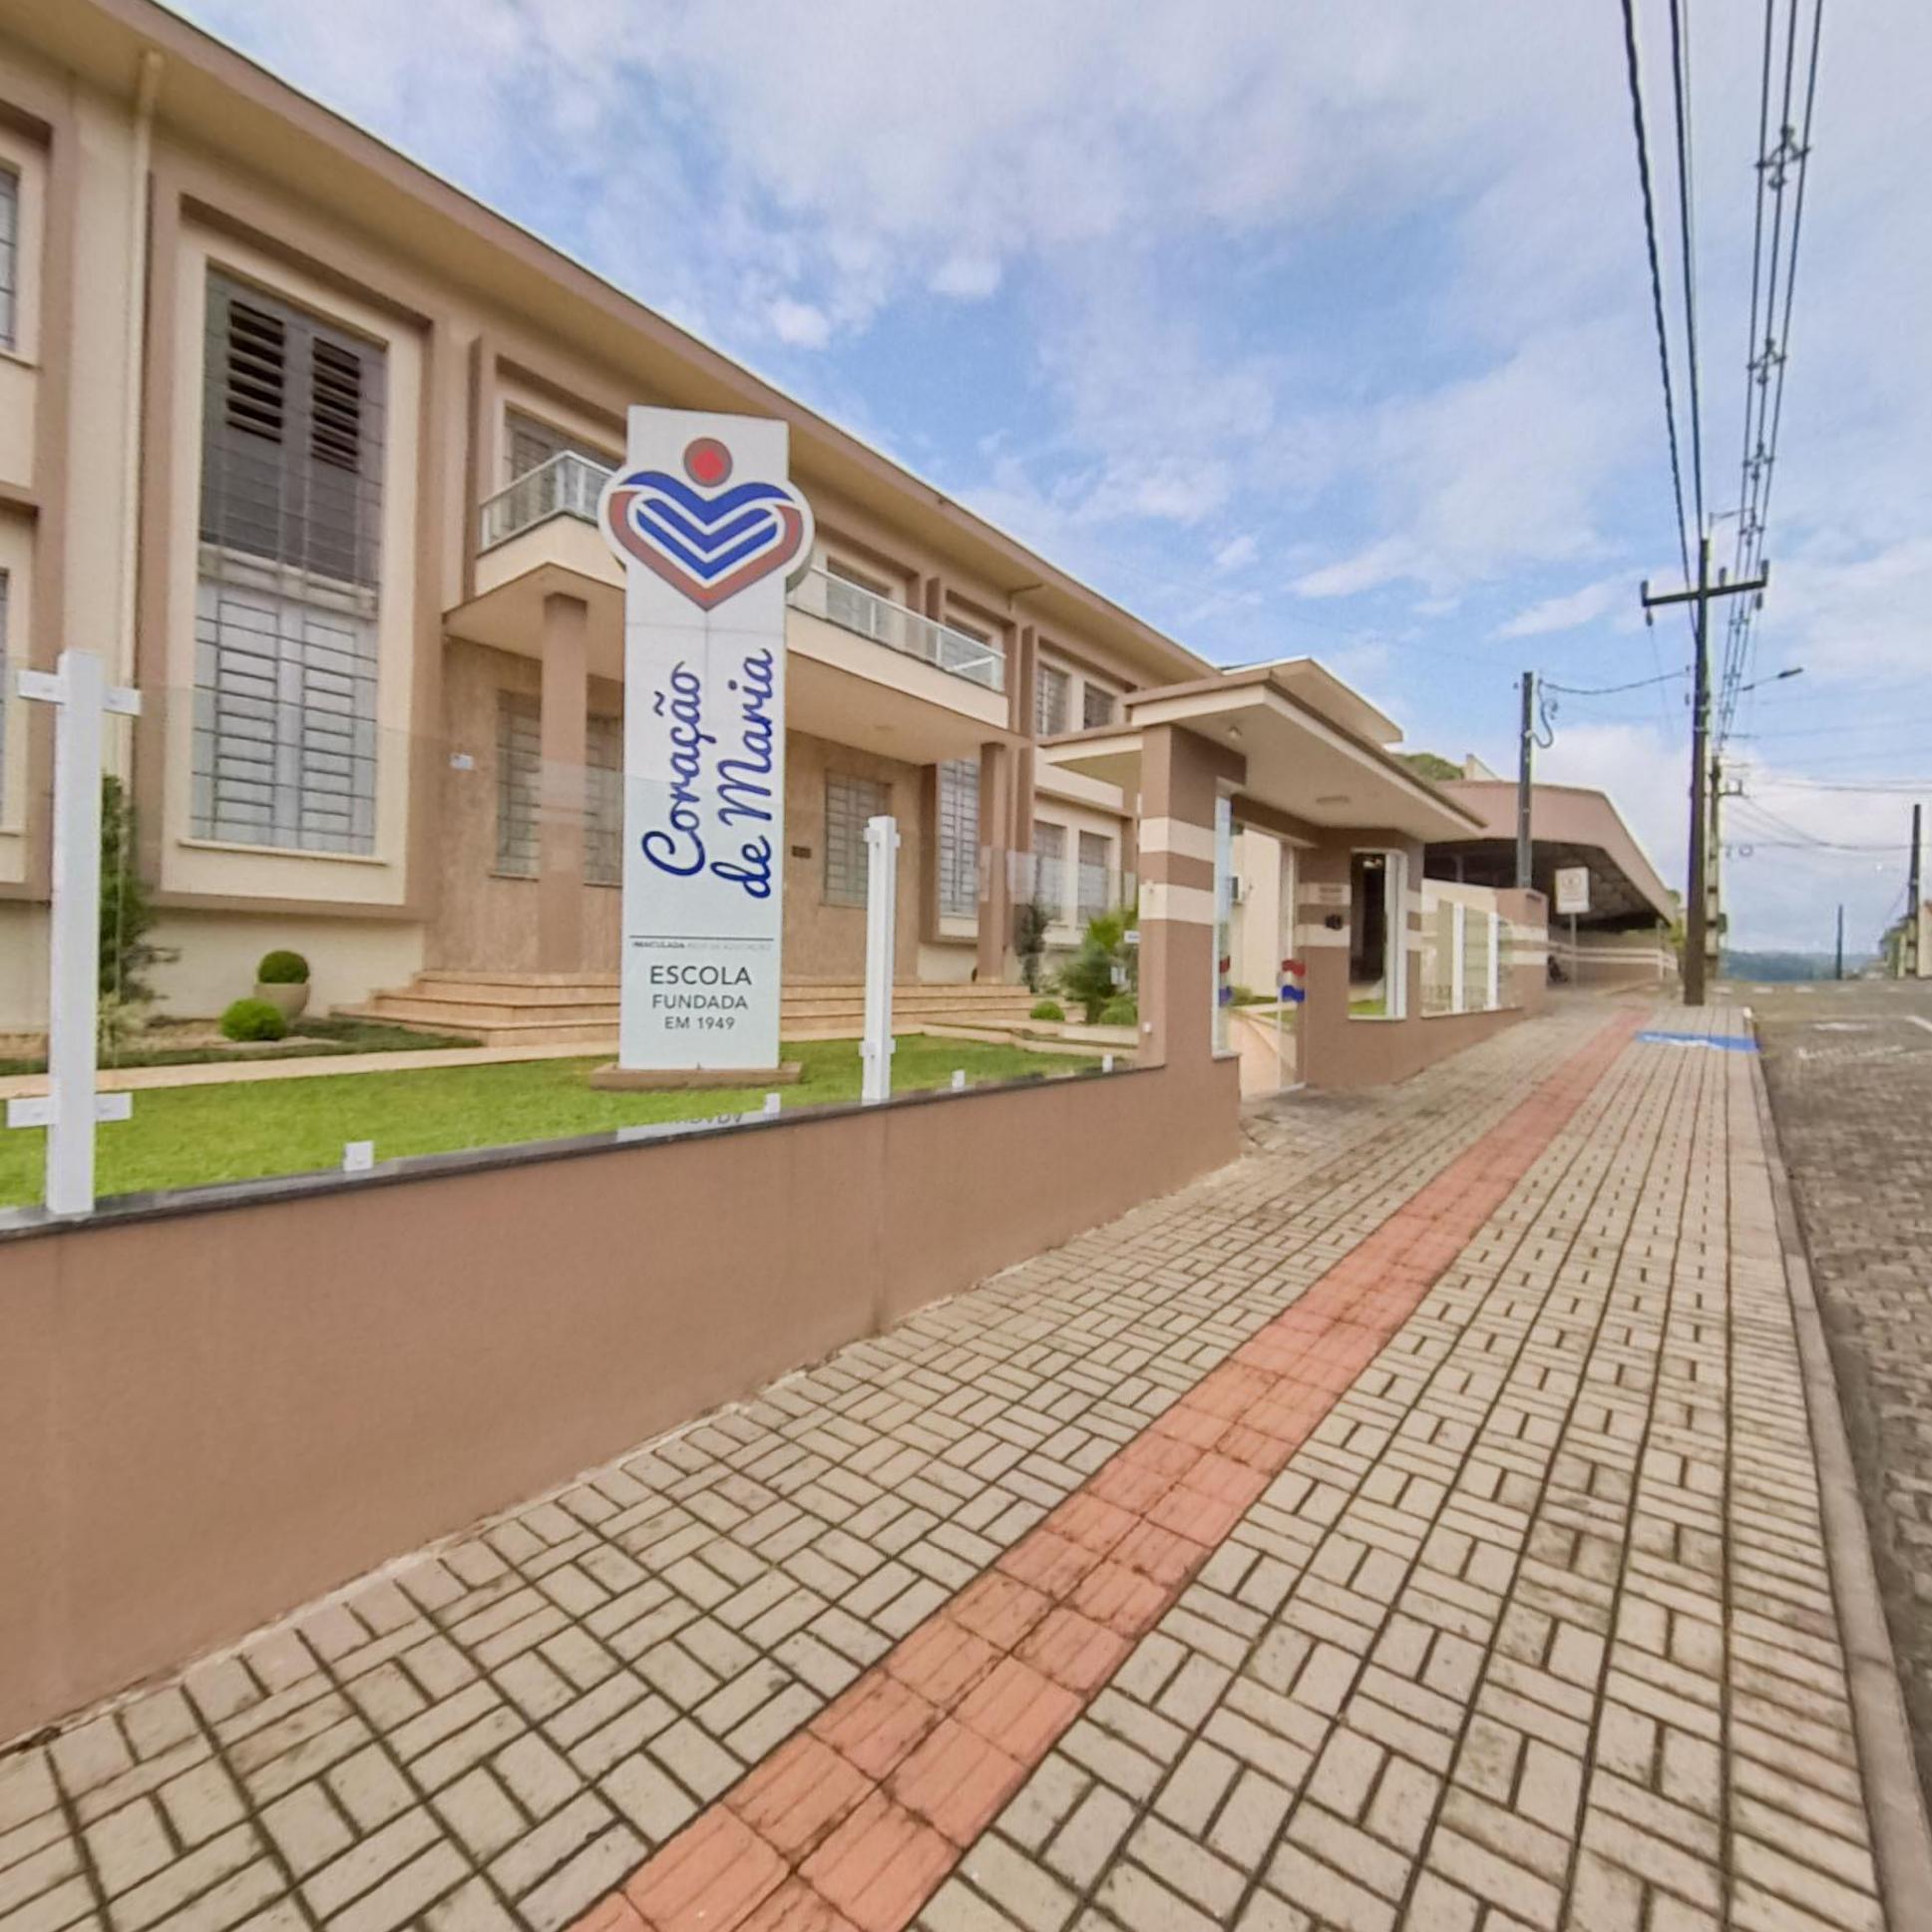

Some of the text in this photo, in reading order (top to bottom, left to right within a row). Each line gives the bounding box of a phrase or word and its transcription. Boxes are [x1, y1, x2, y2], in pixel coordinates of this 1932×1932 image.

[717, 648, 773, 826] Maria
[641, 661, 716, 876] Coração
[710, 835, 771, 899] de
[650, 966, 752, 985] ESCOLA
[652, 994, 748, 1009] FUNDADA
[664, 1016, 736, 1029] EM 1949
